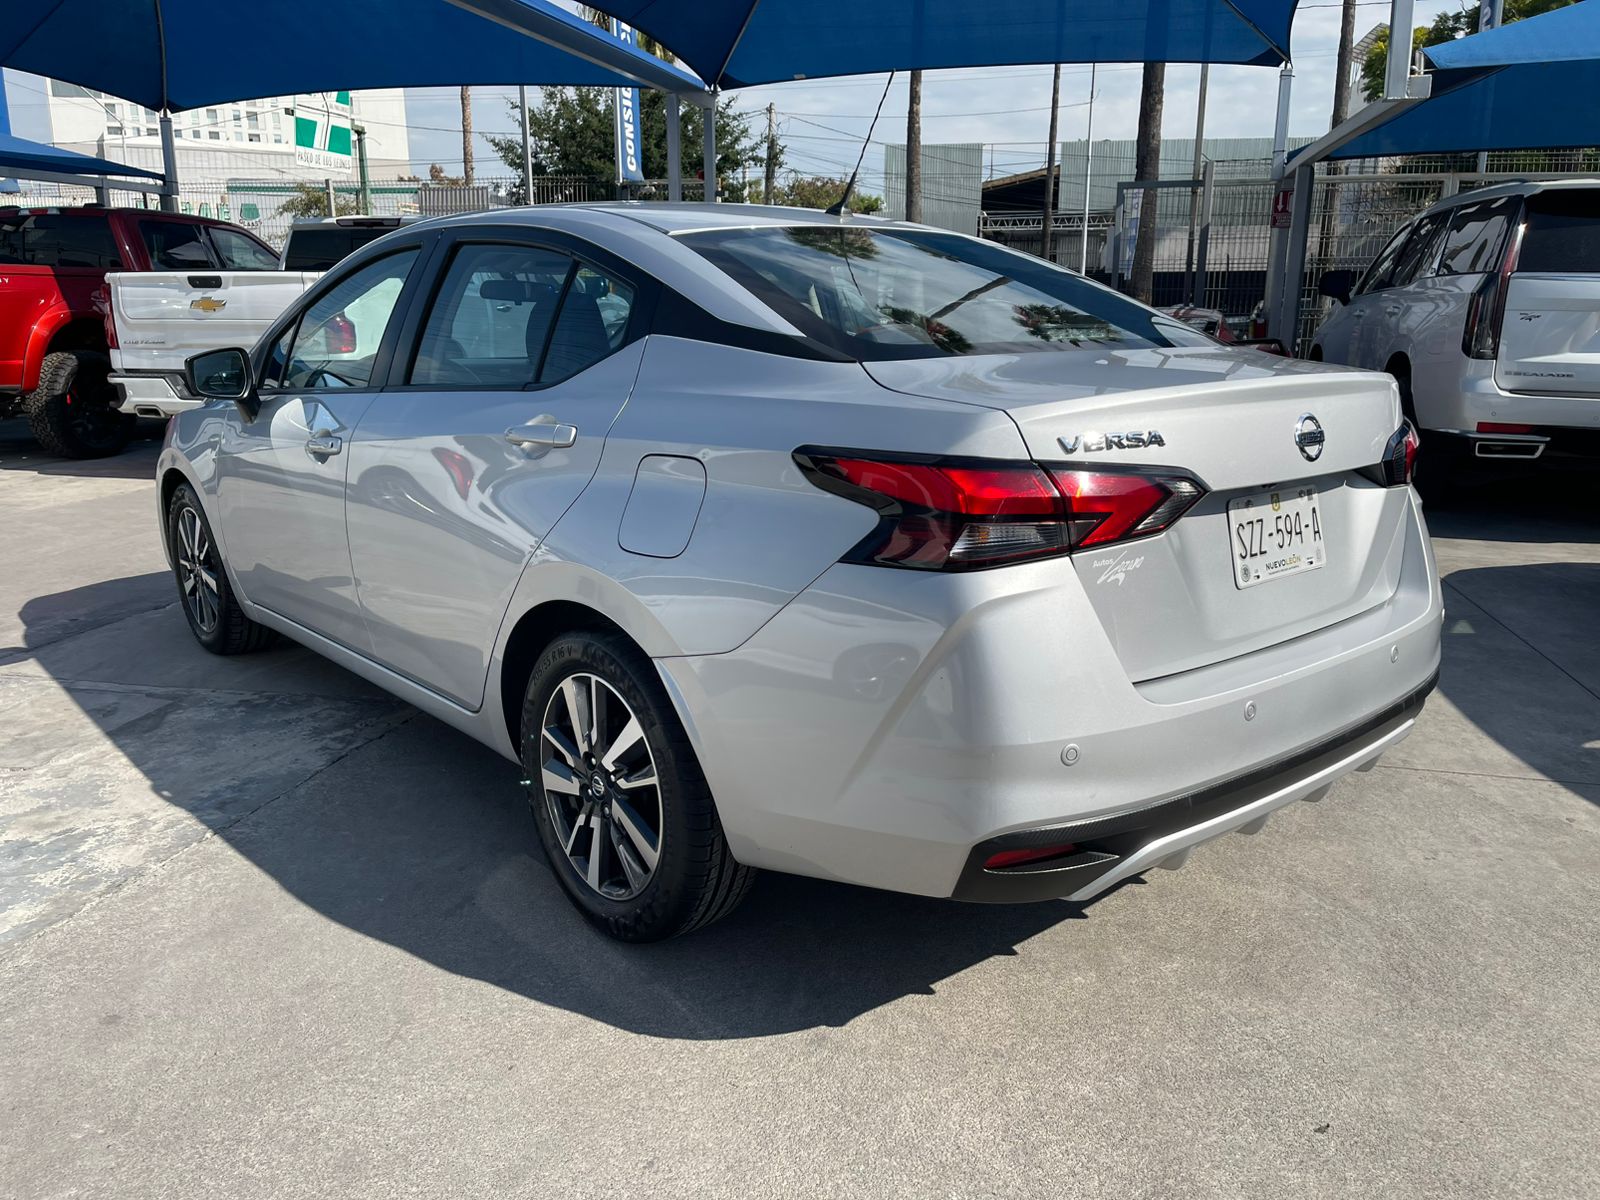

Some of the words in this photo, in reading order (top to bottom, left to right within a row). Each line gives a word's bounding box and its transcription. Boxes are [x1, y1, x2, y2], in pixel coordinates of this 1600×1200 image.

[1056, 430, 1166, 455] VERSA
[1236, 506, 1322, 559] SZZ-594-A
[1092, 559, 1114, 568] Autos
